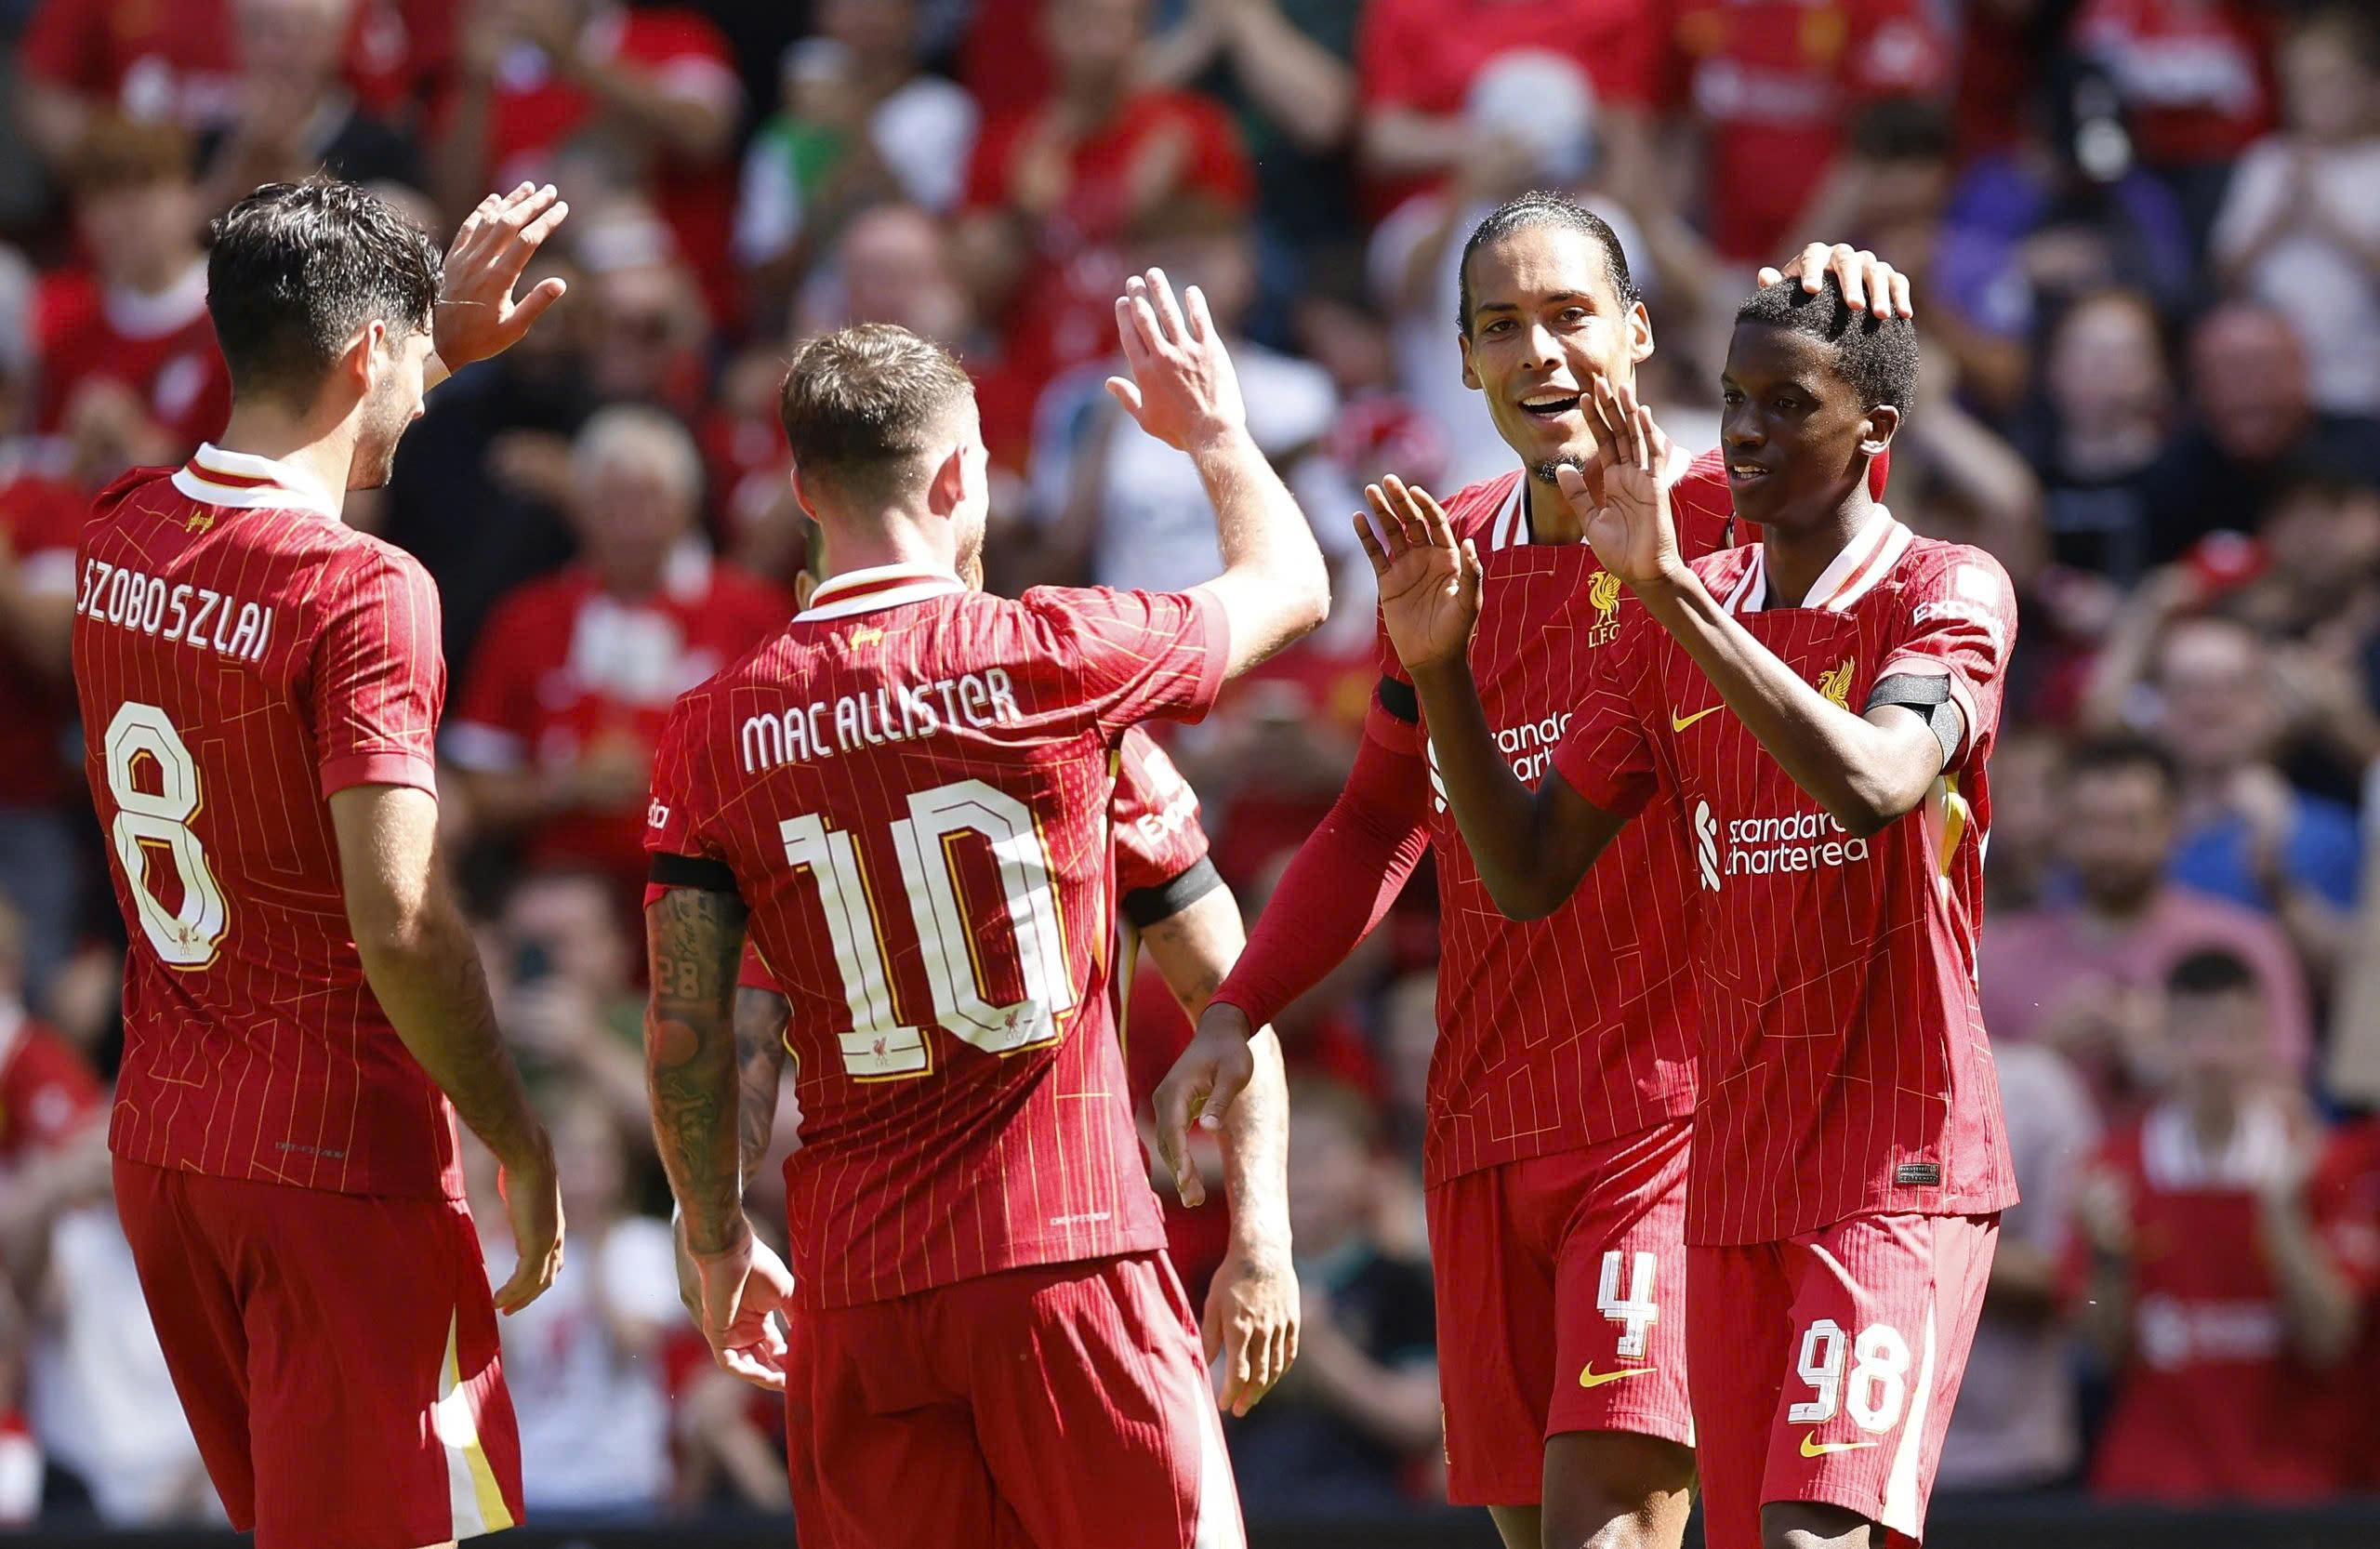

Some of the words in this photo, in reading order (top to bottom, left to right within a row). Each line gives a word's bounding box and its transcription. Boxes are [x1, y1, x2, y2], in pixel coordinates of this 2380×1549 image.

[76, 558, 273, 663] SZOBOSZLAI
[742, 701, 834, 774] MAC
[836, 668, 1023, 753] ALLISTER
[103, 700, 231, 971] 8
[779, 778, 1078, 1083] 10
[1596, 1251, 1659, 1360] 4
[1787, 1318, 1911, 1435] 98
